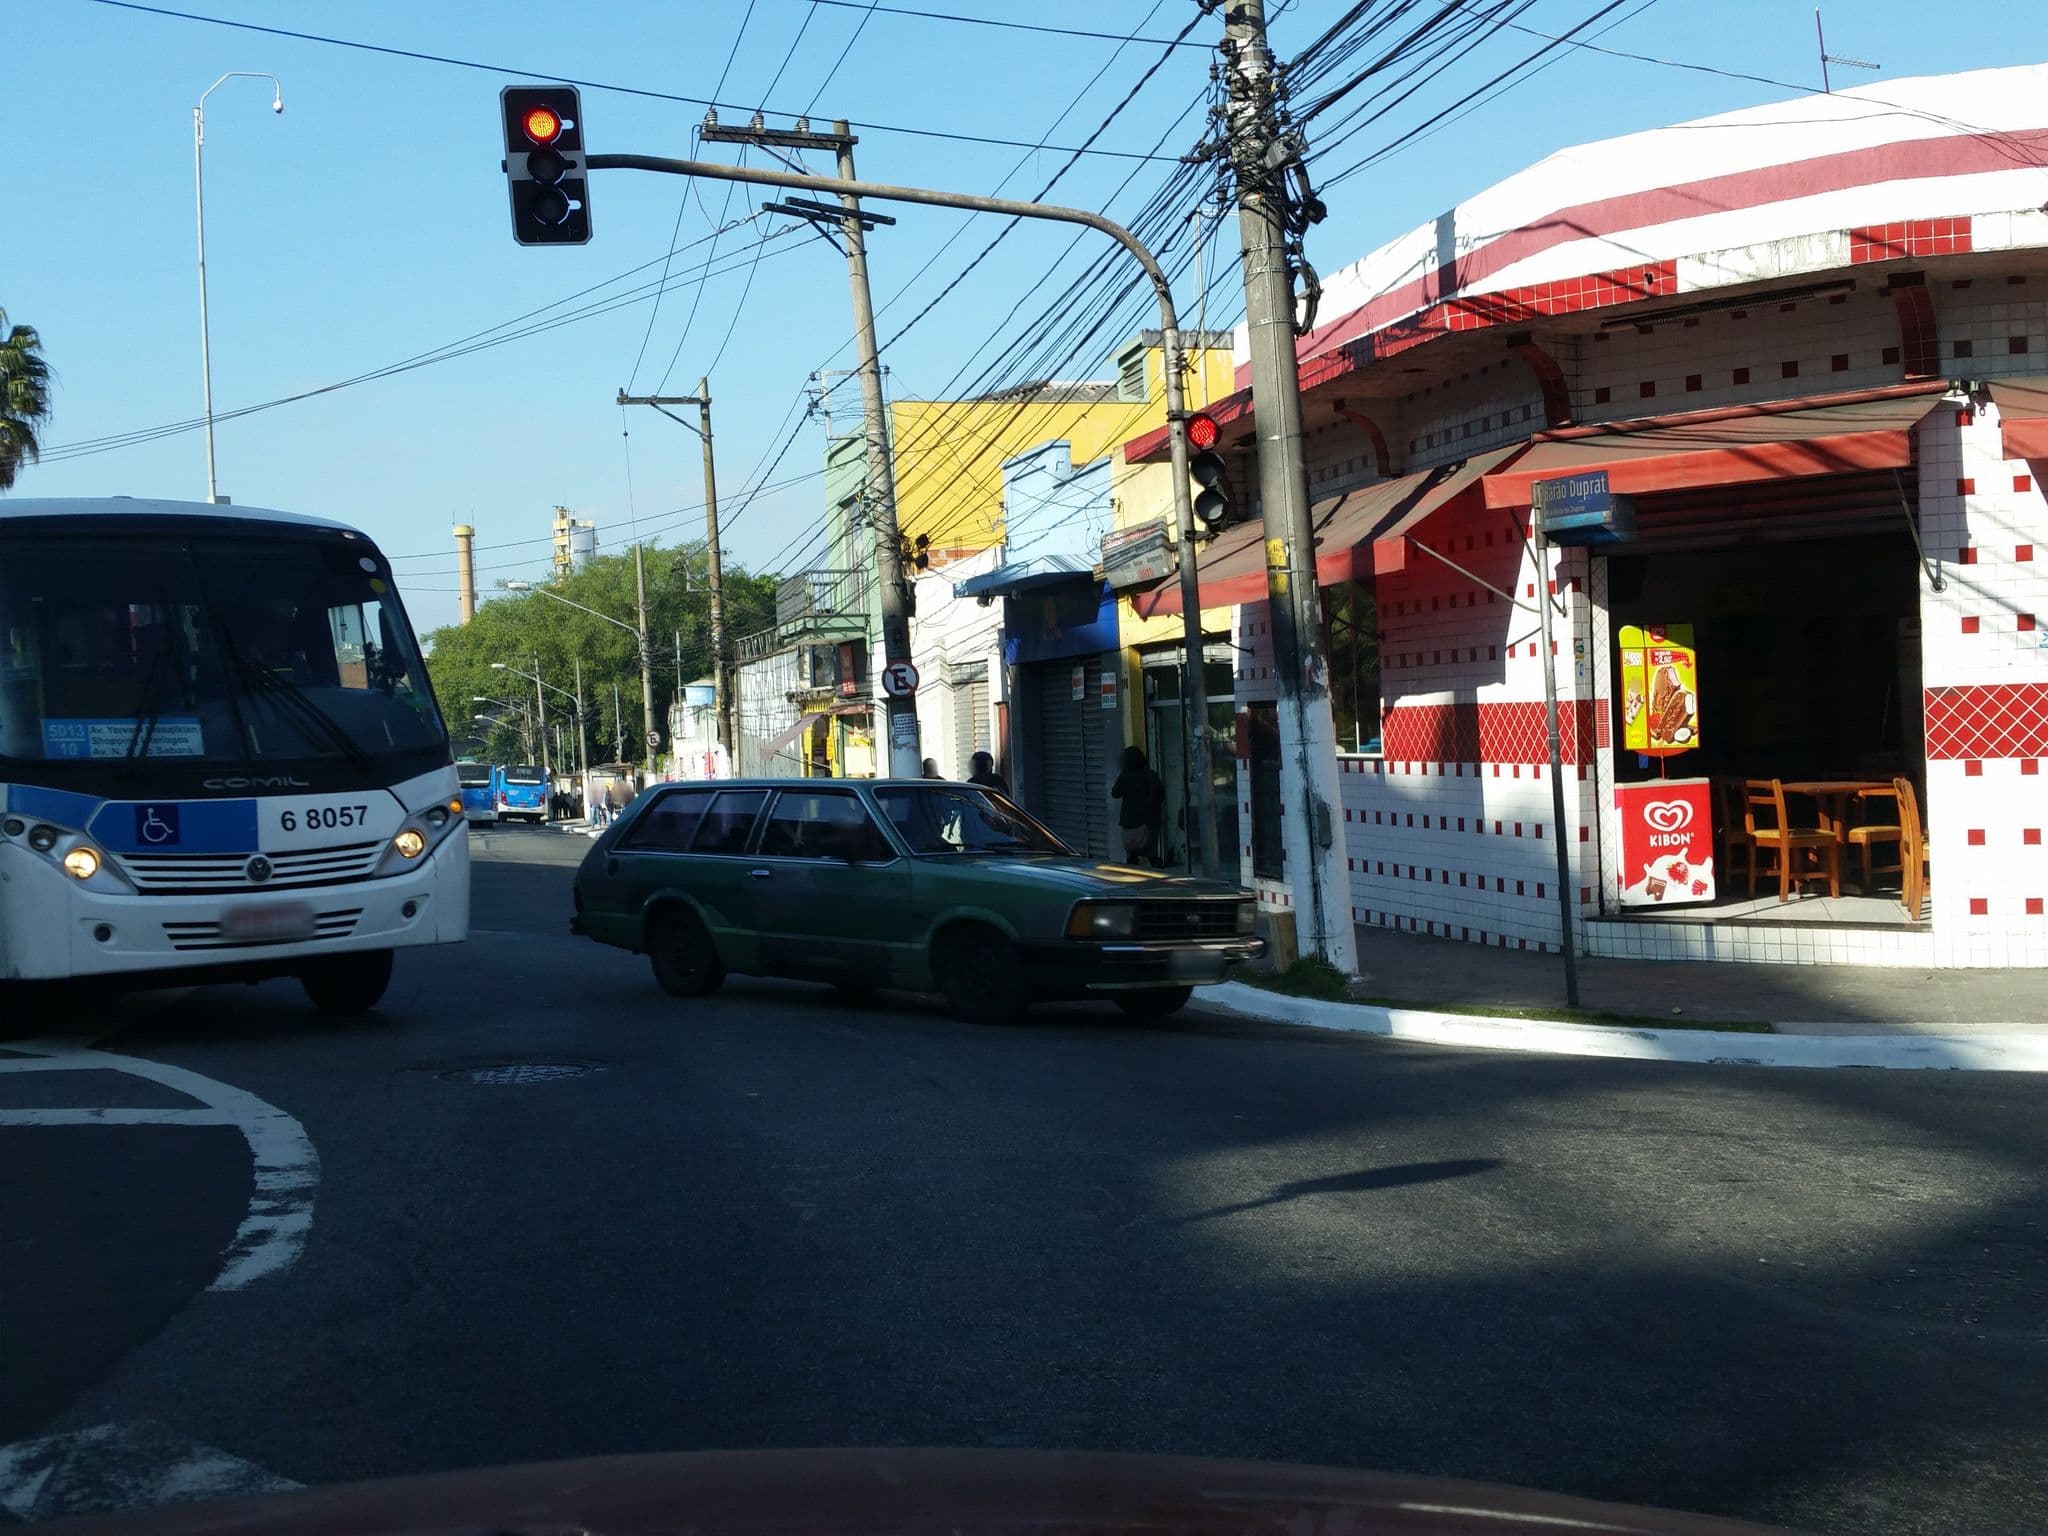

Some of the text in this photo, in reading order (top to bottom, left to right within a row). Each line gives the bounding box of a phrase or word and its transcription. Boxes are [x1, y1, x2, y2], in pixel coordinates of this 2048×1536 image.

[1544, 475, 1607, 502] Barão Duprat
[59, 743, 78, 756] 10
[203, 776, 311, 790] COMIL
[281, 805, 368, 832] 6 8057
[1649, 832, 1691, 848] KIBON
